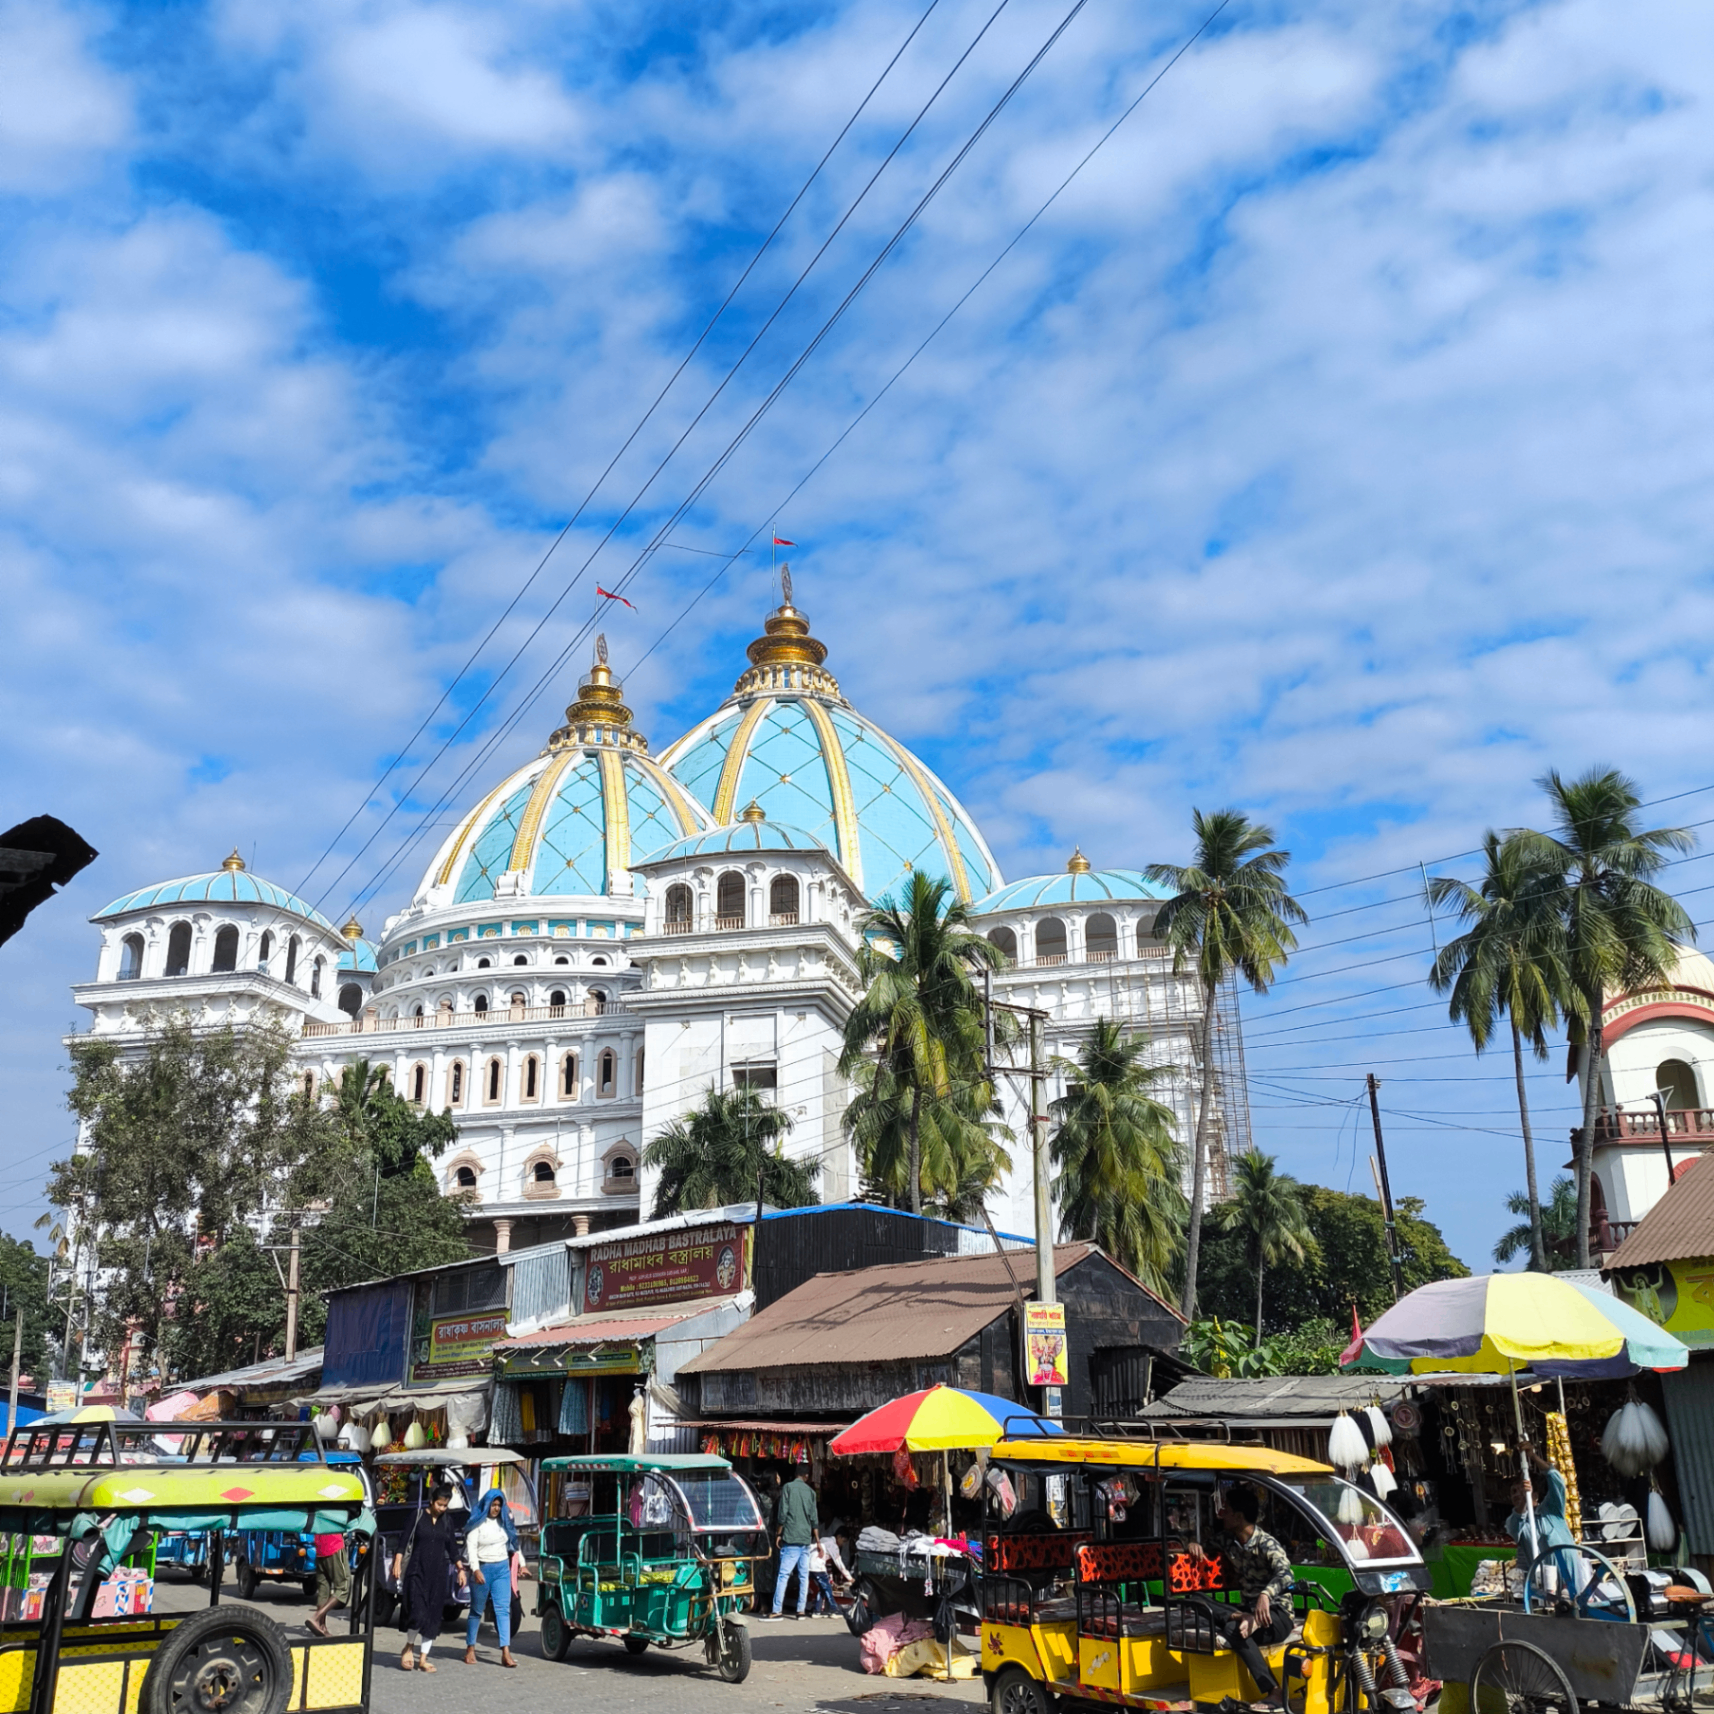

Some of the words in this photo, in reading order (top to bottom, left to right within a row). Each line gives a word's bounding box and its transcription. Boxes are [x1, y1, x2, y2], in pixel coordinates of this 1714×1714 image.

[590, 1244, 622, 1262] RADHA
[624, 1237, 666, 1257] MADHAB
[668, 1225, 737, 1250] BASTRALAYA
[608, 1253, 664, 1274] রাধামাধব
[438, 1323, 469, 1341] রাধাকৃষ্ণ
